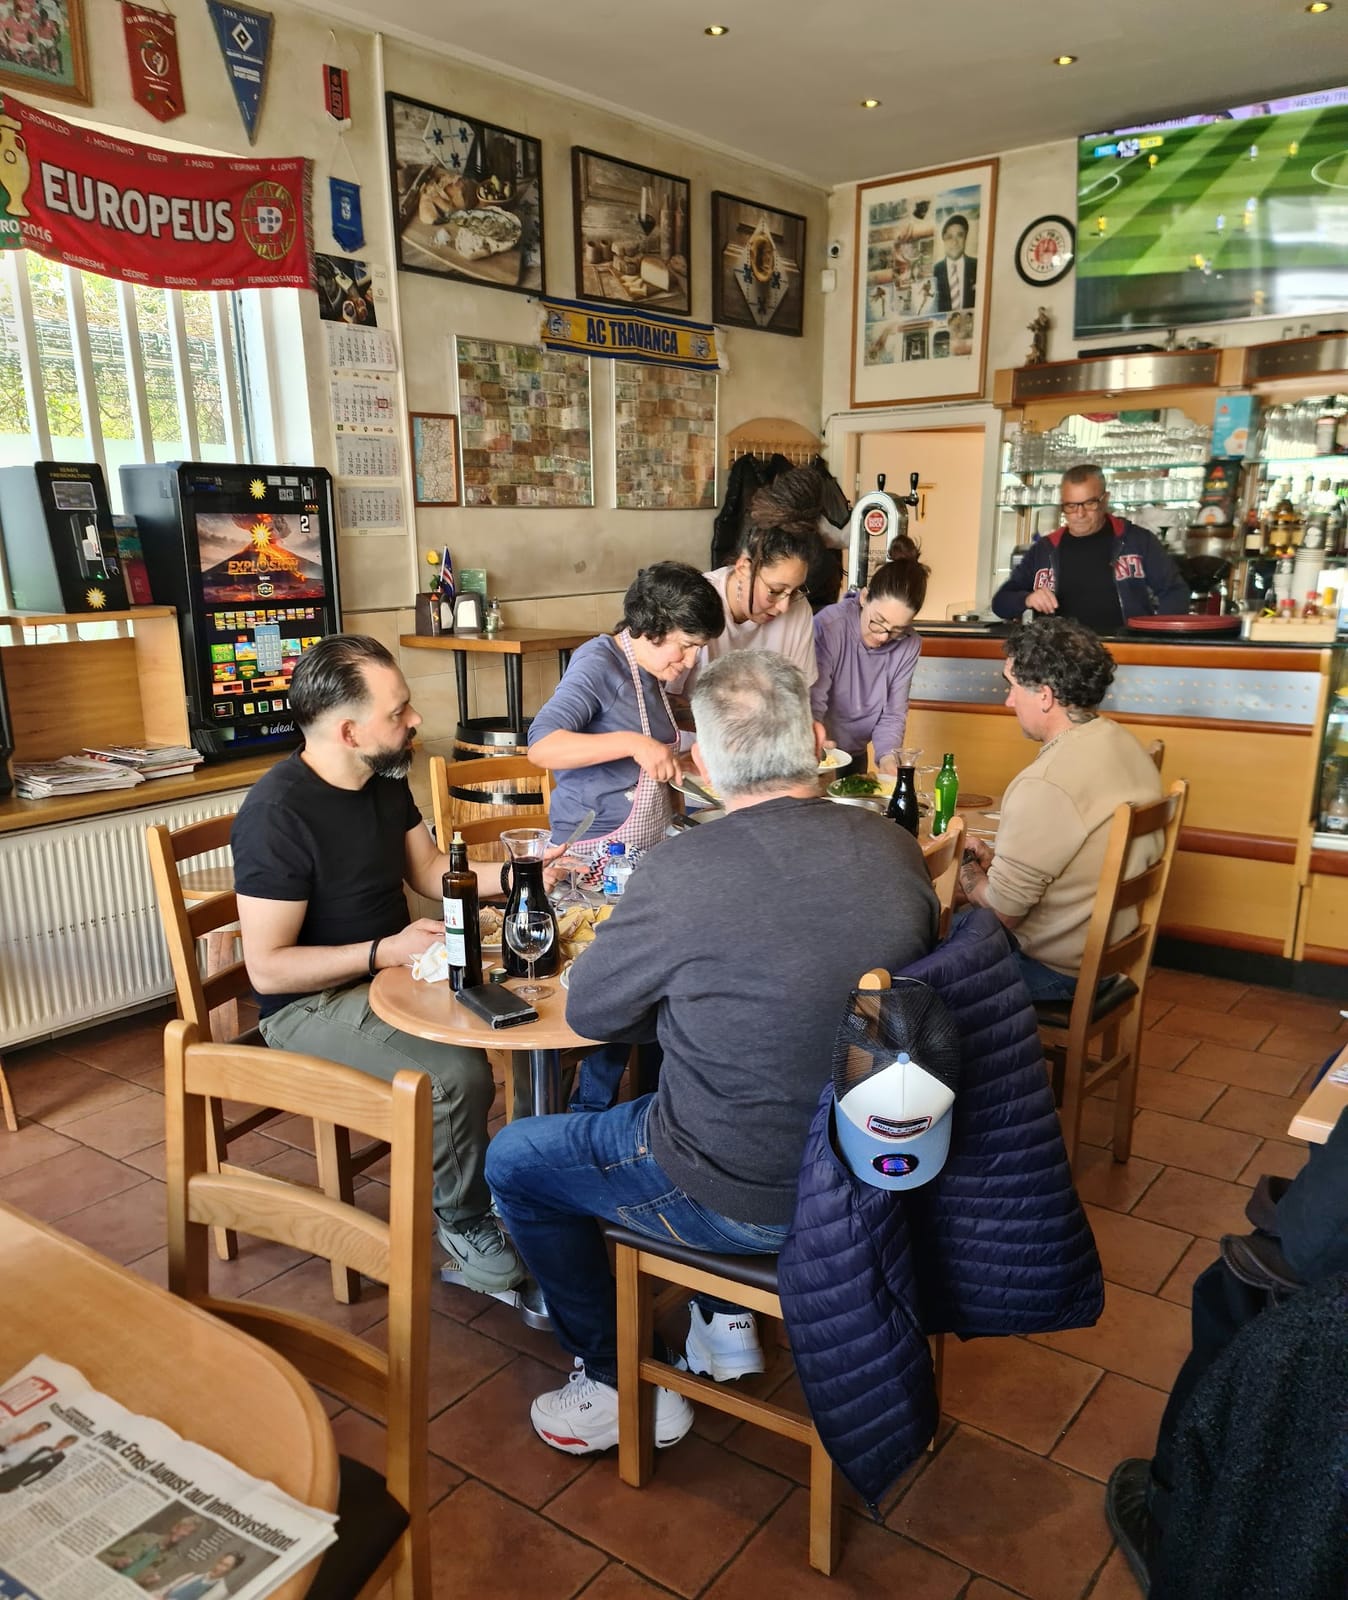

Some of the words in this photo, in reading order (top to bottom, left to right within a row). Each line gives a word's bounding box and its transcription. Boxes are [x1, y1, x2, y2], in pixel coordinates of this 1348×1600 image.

[147, 152, 168, 163] EDER
[40, 160, 236, 243] EUROPEUS
[21, 221, 53, 243] 2016
[62, 251, 106, 272] QUARESMA
[164, 276, 198, 286] EDUARDO
[210, 277, 235, 286] ADRIEN
[247, 276, 279, 284] FERNANDO
[279, 275, 304, 284] SANTOS
[587, 318, 607, 345] AC
[608, 321, 679, 355] TRAVANCA
[300, 515, 310, 533] 2
[227, 558, 299, 575] EXPLOSION
[270, 721, 295, 735] ideal
[728, 1320, 751, 1331] FILA
[578, 1401, 593, 1412] FILA
[92, 1429, 127, 1450] Prinz
[119, 1442, 157, 1472] Ernst
[144, 1461, 194, 1494] August
[183, 1487, 215, 1506] auf
[202, 1497, 301, 1552] Intensivstation!
